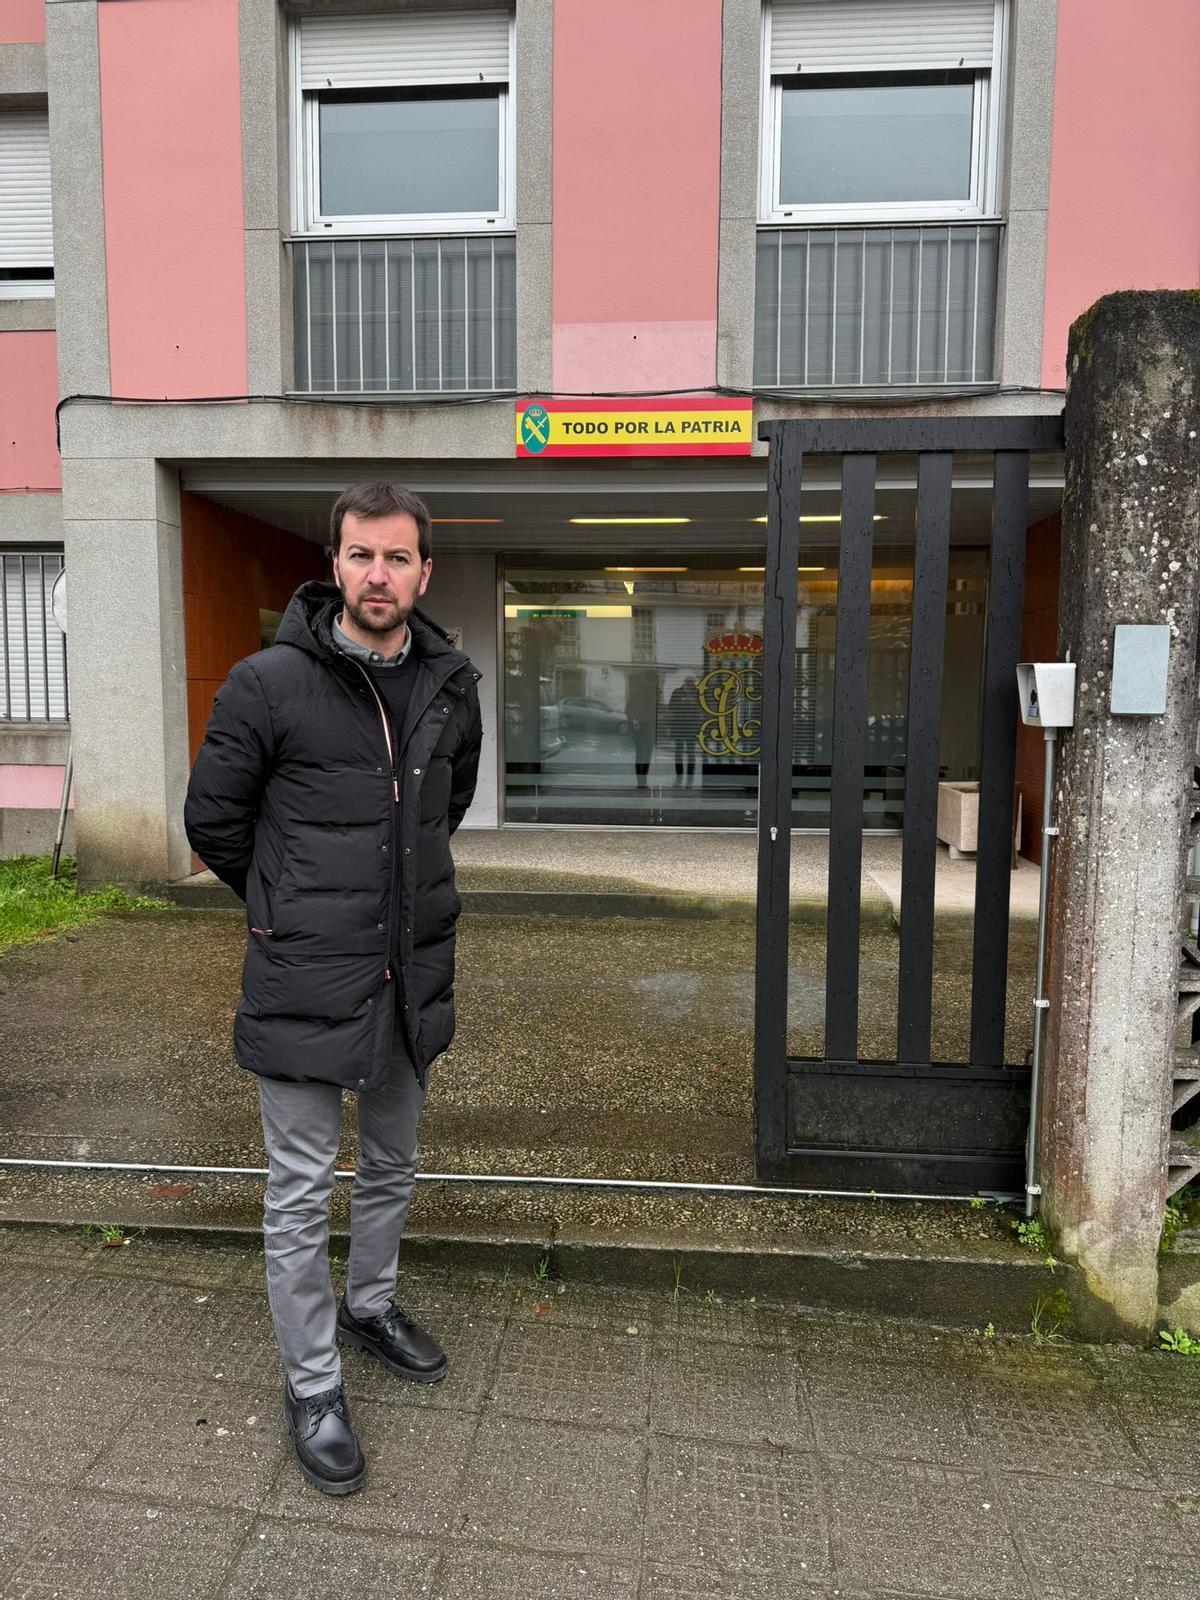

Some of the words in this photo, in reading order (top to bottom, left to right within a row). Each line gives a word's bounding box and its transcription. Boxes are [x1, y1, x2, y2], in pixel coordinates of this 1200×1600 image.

[561, 421, 609, 435] TODO
[614, 421, 649, 434] POR
[654, 421, 676, 434] LA
[681, 420, 742, 433] PATRIA
